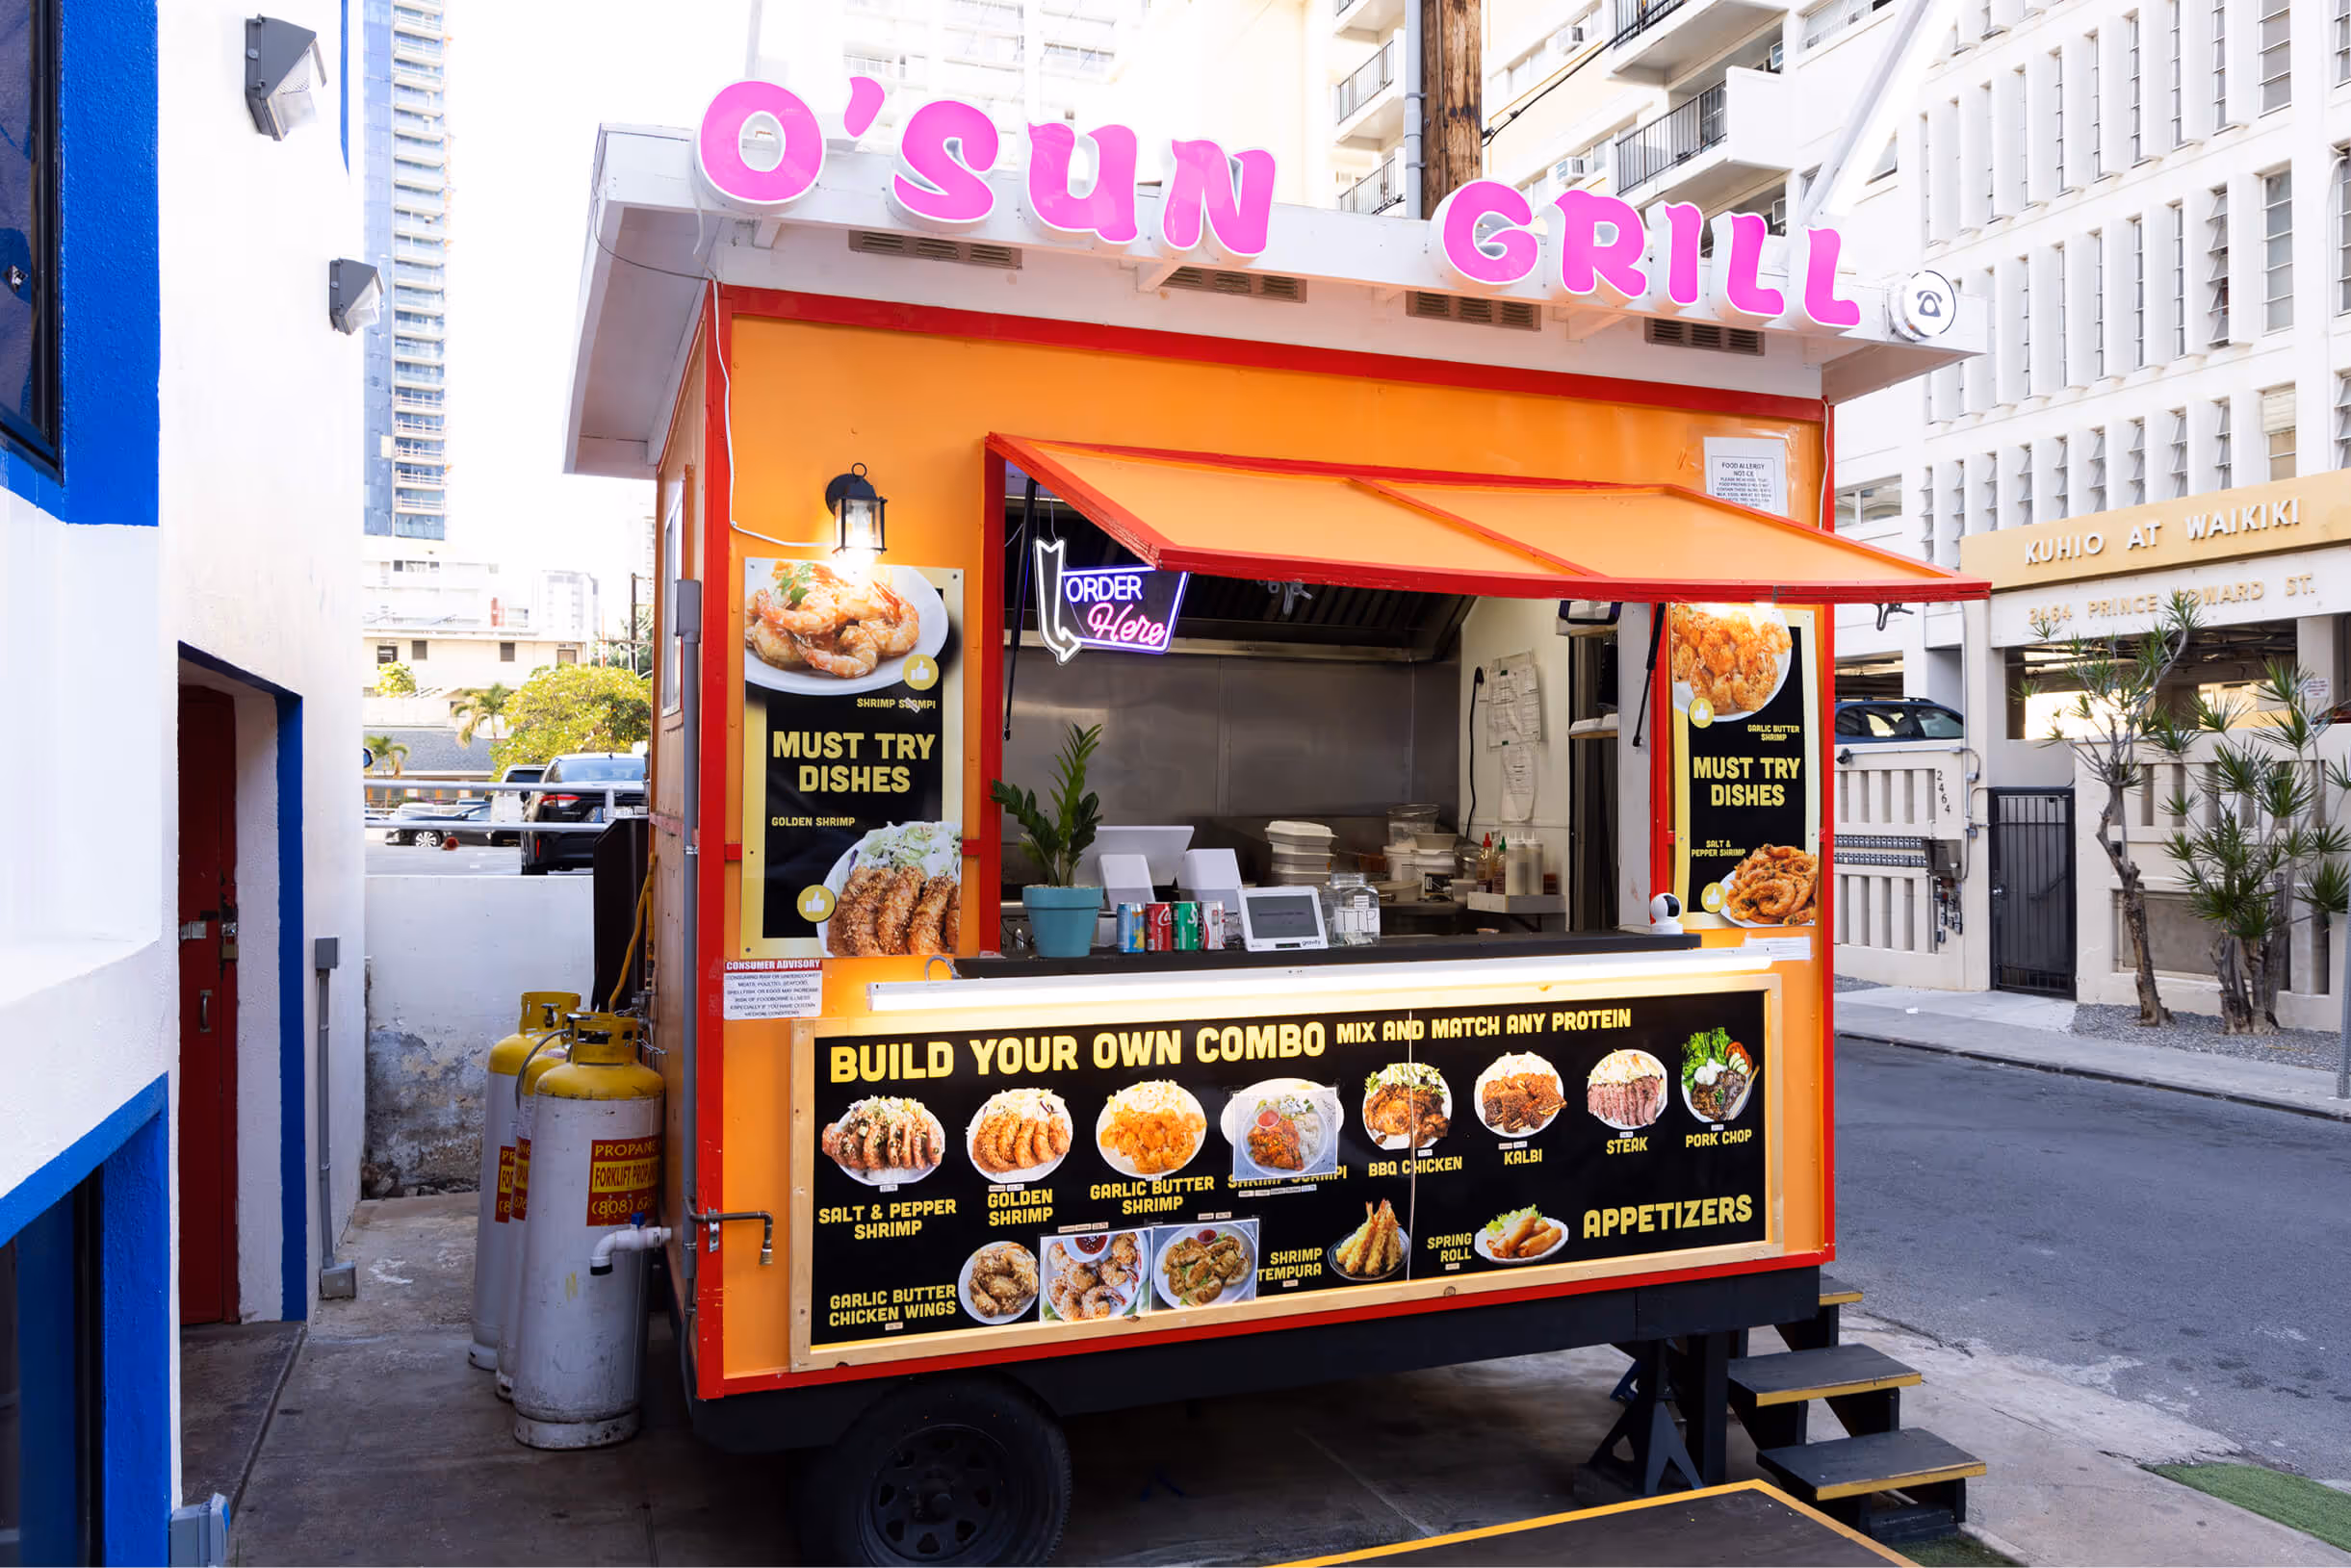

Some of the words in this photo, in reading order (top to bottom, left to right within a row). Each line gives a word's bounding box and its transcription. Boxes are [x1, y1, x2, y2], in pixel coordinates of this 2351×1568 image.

[697, 75, 1277, 258] O'SUN
[1440, 179, 1862, 328] GRILL
[2025, 531, 2106, 566] KUHIO
[2127, 523, 2162, 551] AT
[2185, 498, 2301, 541] WAIKIKI
[1066, 575, 1143, 603] ORDER
[2028, 604, 2072, 626] 2464
[2087, 593, 2157, 619] PRINCE
[2286, 574, 2316, 597] ST.
[1087, 602, 1166, 646] Here
[856, 697, 895, 708] SHRIMP
[898, 698, 936, 709] SMPI
[1747, 724, 1771, 733] GARLIC
[772, 731, 865, 759] MUST
[874, 733, 936, 760] TRY
[1692, 757, 1753, 780] MUST
[1760, 757, 1801, 780] TRY
[798, 765, 911, 793] DISHES
[1710, 784, 1785, 807] DISHES
[771, 817, 813, 827] GOLDEN
[815, 817, 856, 827] SHRIMP
[1691, 849, 1718, 858] PEPPER
[1719, 848, 1745, 857] SHRIMP
[1706, 839, 1724, 848] SALT
[1339, 910, 1377, 932] TIP
[726, 960, 775, 970] CONSUMER
[776, 959, 821, 969] ADVISORY
[830, 1041, 954, 1084] BUILD
[969, 1035, 1079, 1076] YOUR
[1093, 1029, 1182, 1069] OWN
[1196, 1021, 1326, 1064] COMBO
[1336, 1021, 1377, 1044] MIX
[1382, 1018, 1425, 1041] AND
[1431, 1015, 1500, 1040] MATCH
[1506, 1013, 1546, 1035] ANY
[1551, 1008, 1632, 1032] PROTEIN
[1606, 1137, 1648, 1155] STEAK
[1686, 1132, 1718, 1148] PORK
[1721, 1128, 1752, 1145] CHOP
[595, 1141, 656, 1157] PROPAN
[1504, 1148, 1543, 1166] KALBI
[595, 1166, 631, 1187] FORKLIFT
[1368, 1160, 1398, 1178] BBQ
[1402, 1155, 1462, 1175] CHICKEN
[1090, 1180, 1147, 1200] GARLIC
[1151, 1176, 1215, 1195] BUTTER
[591, 1198, 633, 1215] (808)
[987, 1189, 1053, 1209] GOLDEN
[1122, 1195, 1183, 1215] SHRIMP
[818, 1205, 865, 1224] SALT
[870, 1204, 883, 1221] &
[890, 1198, 957, 1219] PEPPER
[989, 1207, 1053, 1226] SHRIMP
[1583, 1194, 1753, 1239] APPETIZERS
[854, 1220, 922, 1240] SHRIMP
[1427, 1233, 1472, 1250] SPRING
[1270, 1247, 1323, 1266] SHRIMP
[1440, 1246, 1472, 1262] ROLL
[1256, 1262, 1322, 1282] TEMPURA
[830, 1290, 888, 1310] GARLIC
[892, 1284, 956, 1303] BUTTER
[829, 1306, 899, 1326] CHICKEN
[904, 1300, 956, 1320] WINGS
